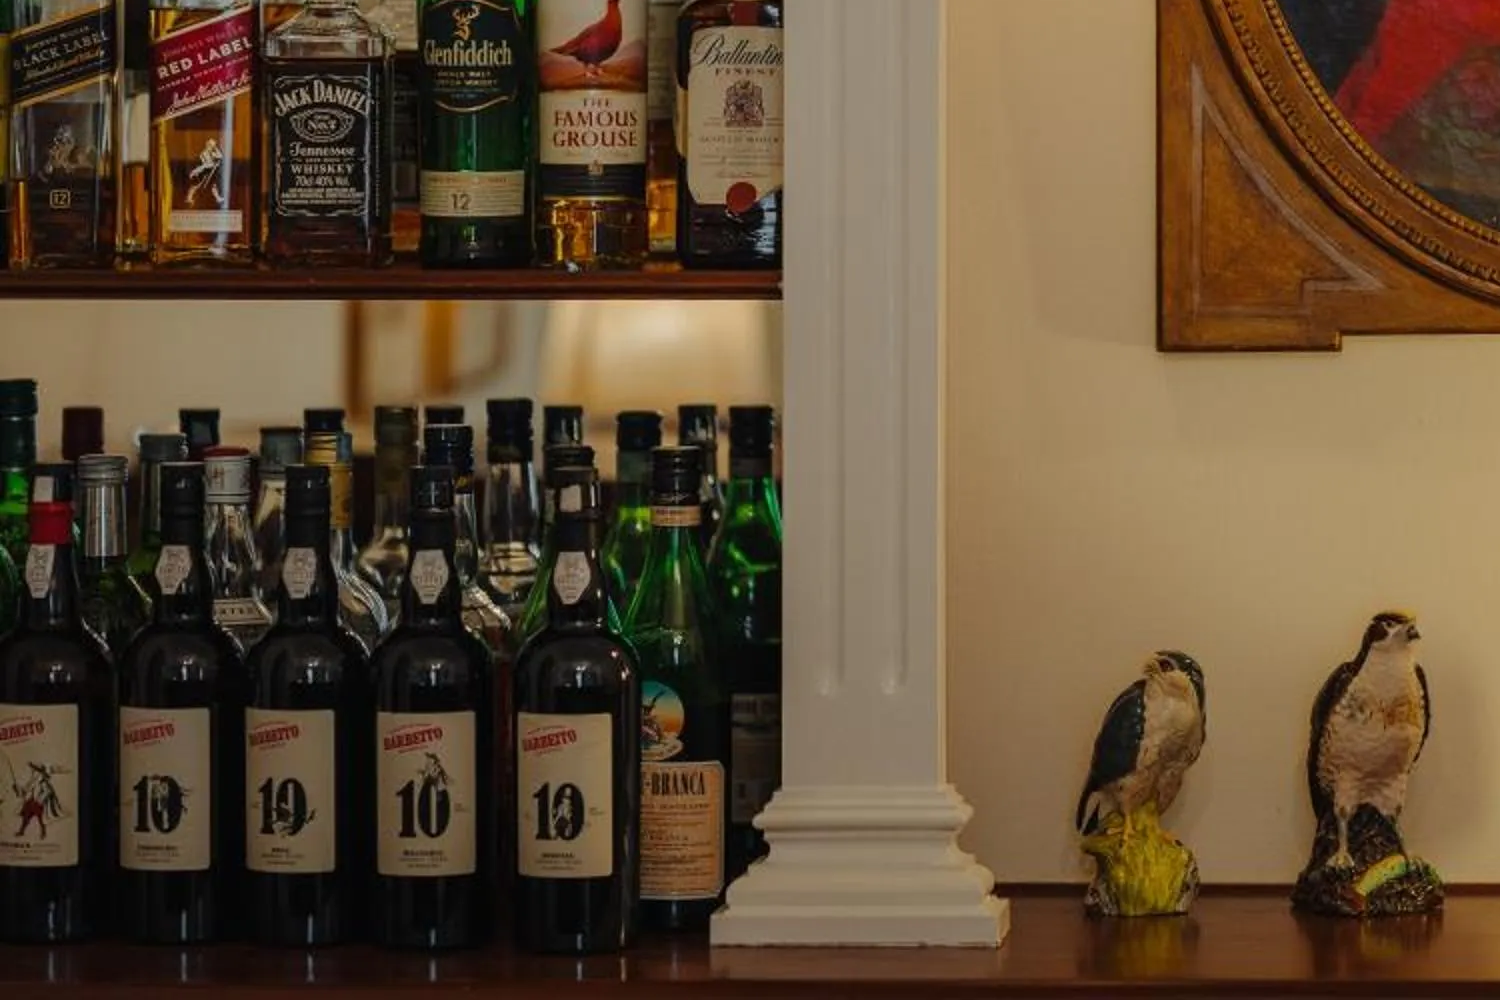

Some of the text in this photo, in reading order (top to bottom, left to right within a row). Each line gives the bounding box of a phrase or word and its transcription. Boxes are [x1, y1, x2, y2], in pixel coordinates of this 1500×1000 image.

[157, 57, 193, 79] RED
[197, 36, 253, 65] LABEL
[424, 39, 512, 67] Glenfiddich
[274, 84, 313, 117] JACK
[554, 110, 639, 128] FAMOUS
[289, 141, 356, 158] Tennessee
[553, 131, 638, 148] GROUSE
[290, 163, 355, 175] WHISKEY
[450, 193, 472, 210] 12
[0, 719, 45, 741] RBEITO
[383, 726, 444, 751] BARBEITO
[132, 774, 183, 835] 10
[395, 779, 451, 839] 10
[531, 781, 585, 841] 10
